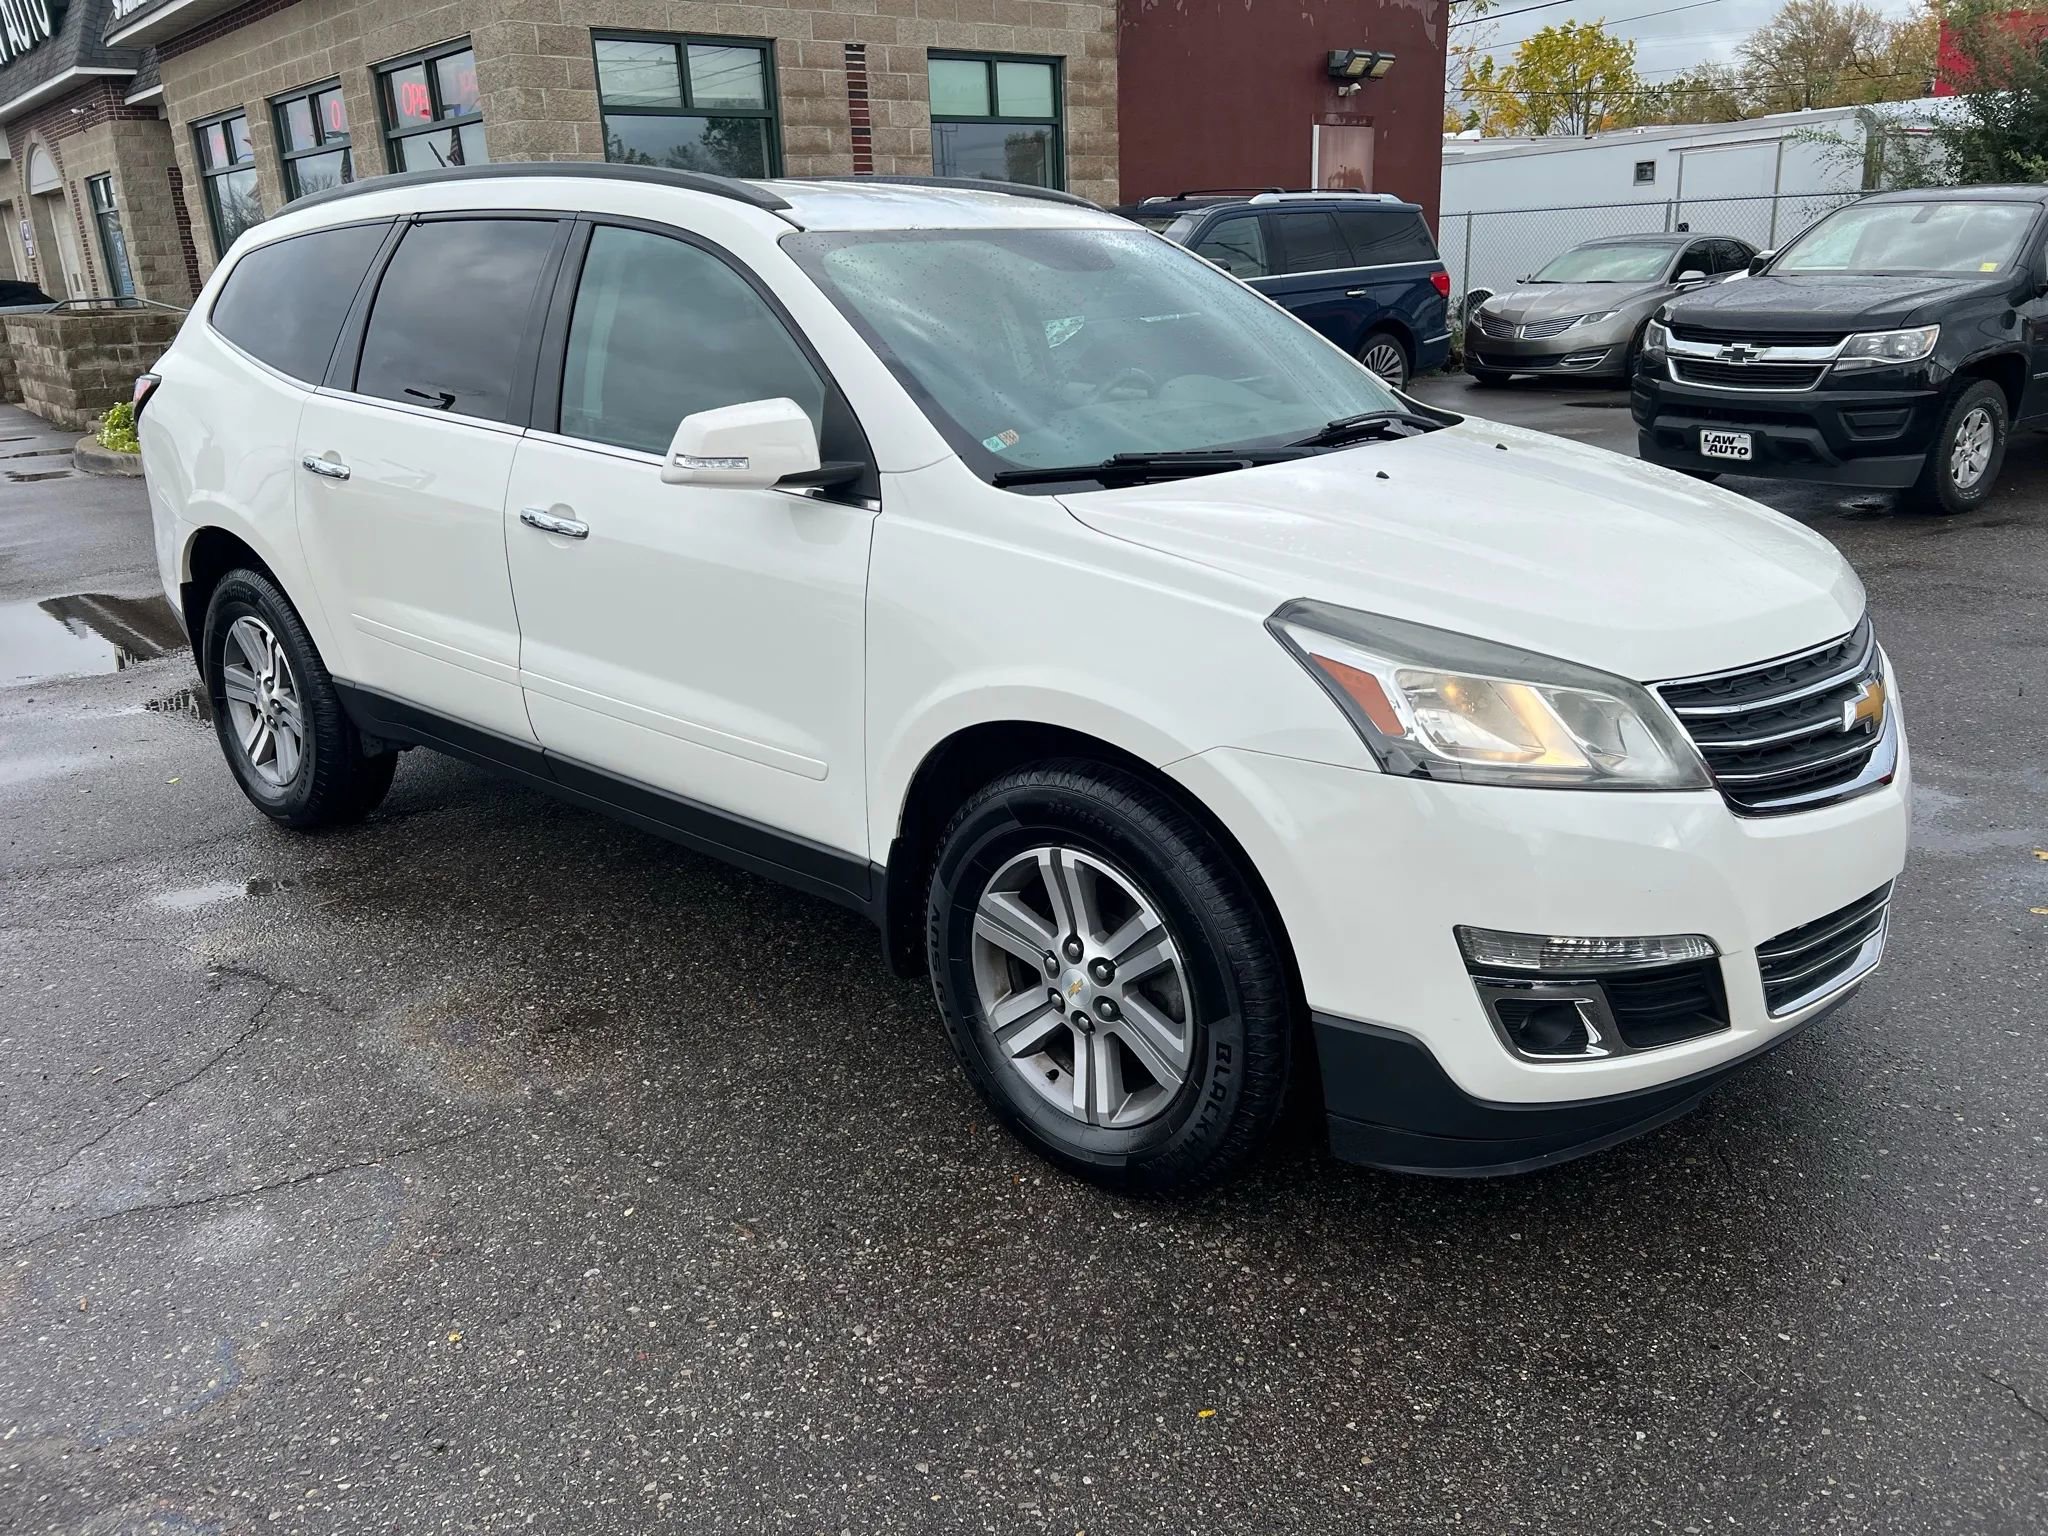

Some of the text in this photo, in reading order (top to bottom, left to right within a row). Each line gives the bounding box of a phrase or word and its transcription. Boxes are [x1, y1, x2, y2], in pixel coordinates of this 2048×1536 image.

[401, 80, 431, 118] OPE
[1703, 434, 1736, 445] LAW
[1708, 444, 1749, 455] AUTO
[930, 902, 942, 973] SUV
